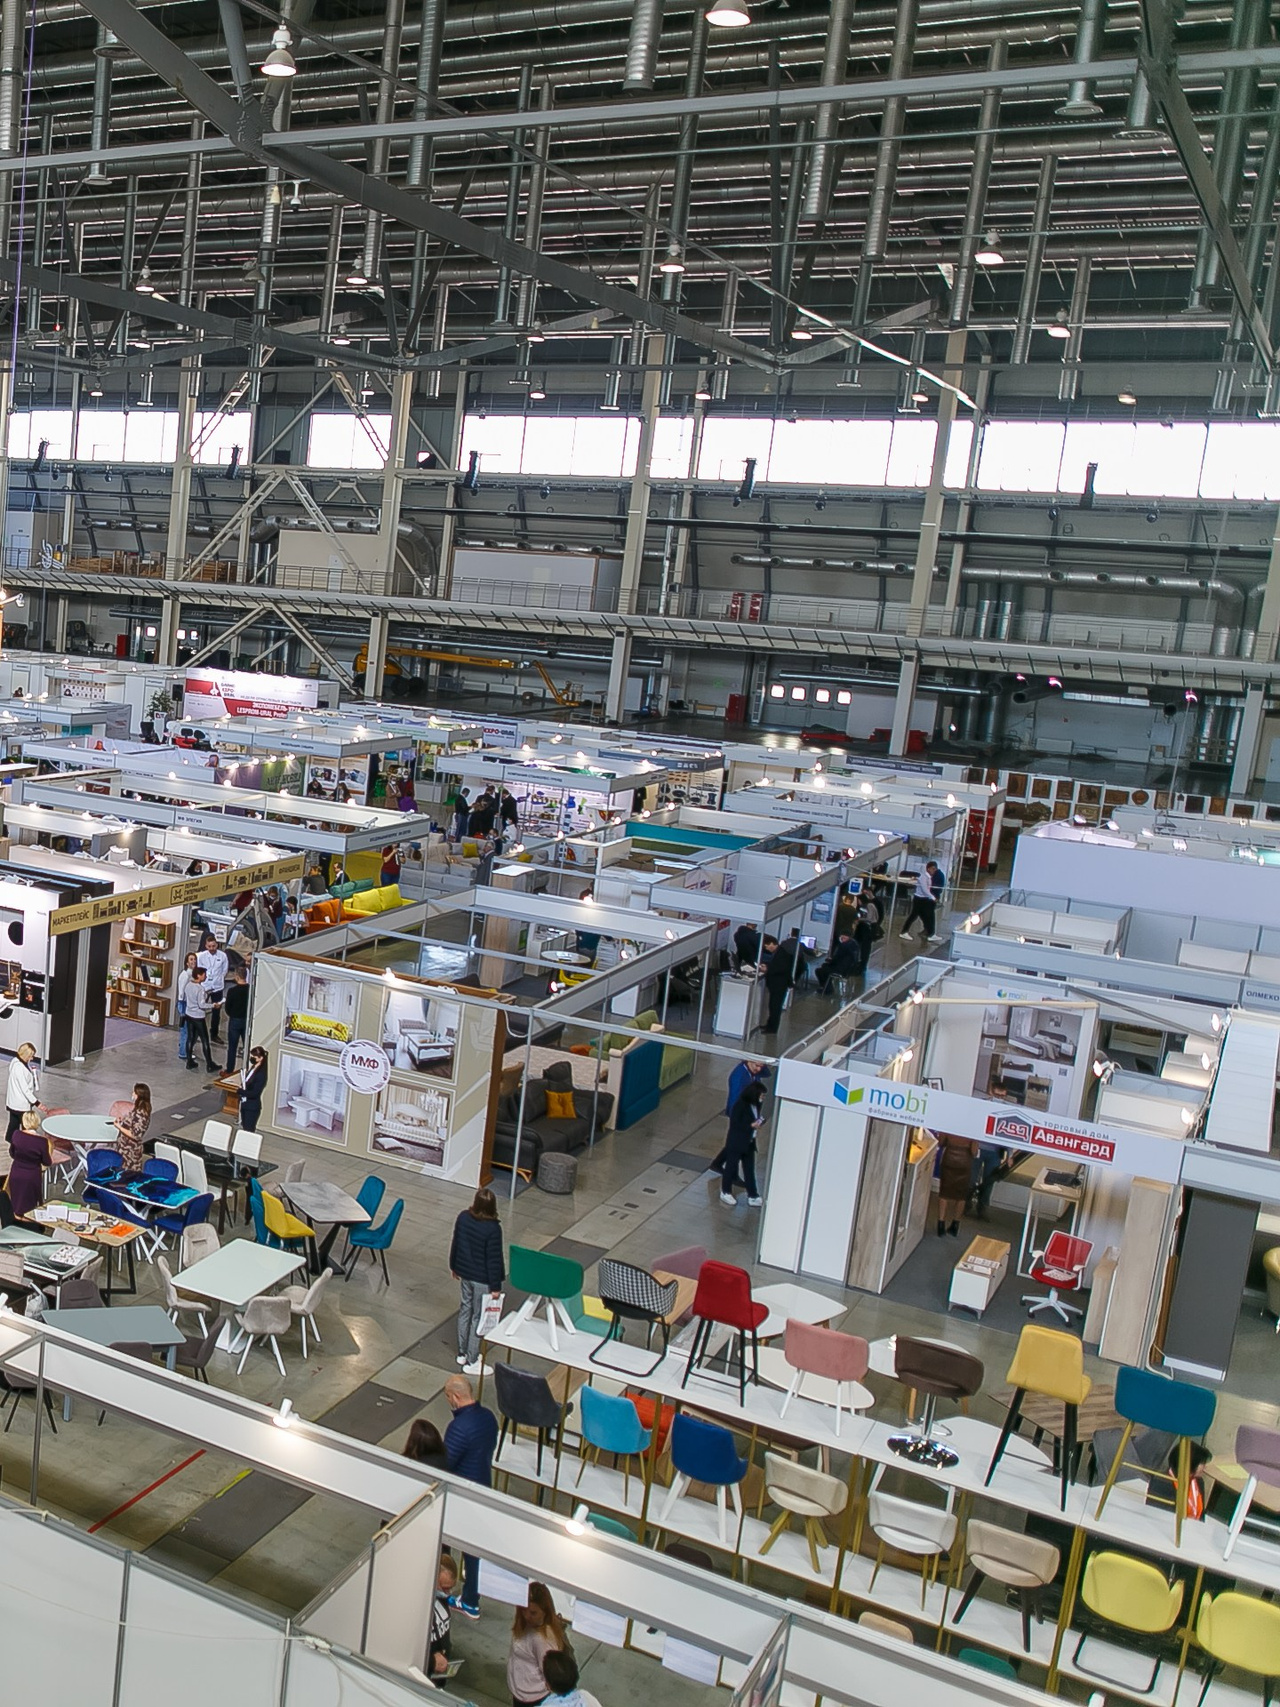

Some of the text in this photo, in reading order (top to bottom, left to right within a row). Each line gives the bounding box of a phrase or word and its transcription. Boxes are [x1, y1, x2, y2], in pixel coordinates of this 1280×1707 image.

[52, 909, 91, 927] МАРКЕТПЛЕЙС
[1246, 990, 1280, 1001] ОЛМЕКО
[351, 1054, 379, 1069] ММФ
[869, 1087, 928, 1115] mobi
[868, 1107, 924, 1124] фабрика мебели
[1043, 1120, 1109, 1141] торговый дом
[1033, 1129, 1112, 1159] Авангард
